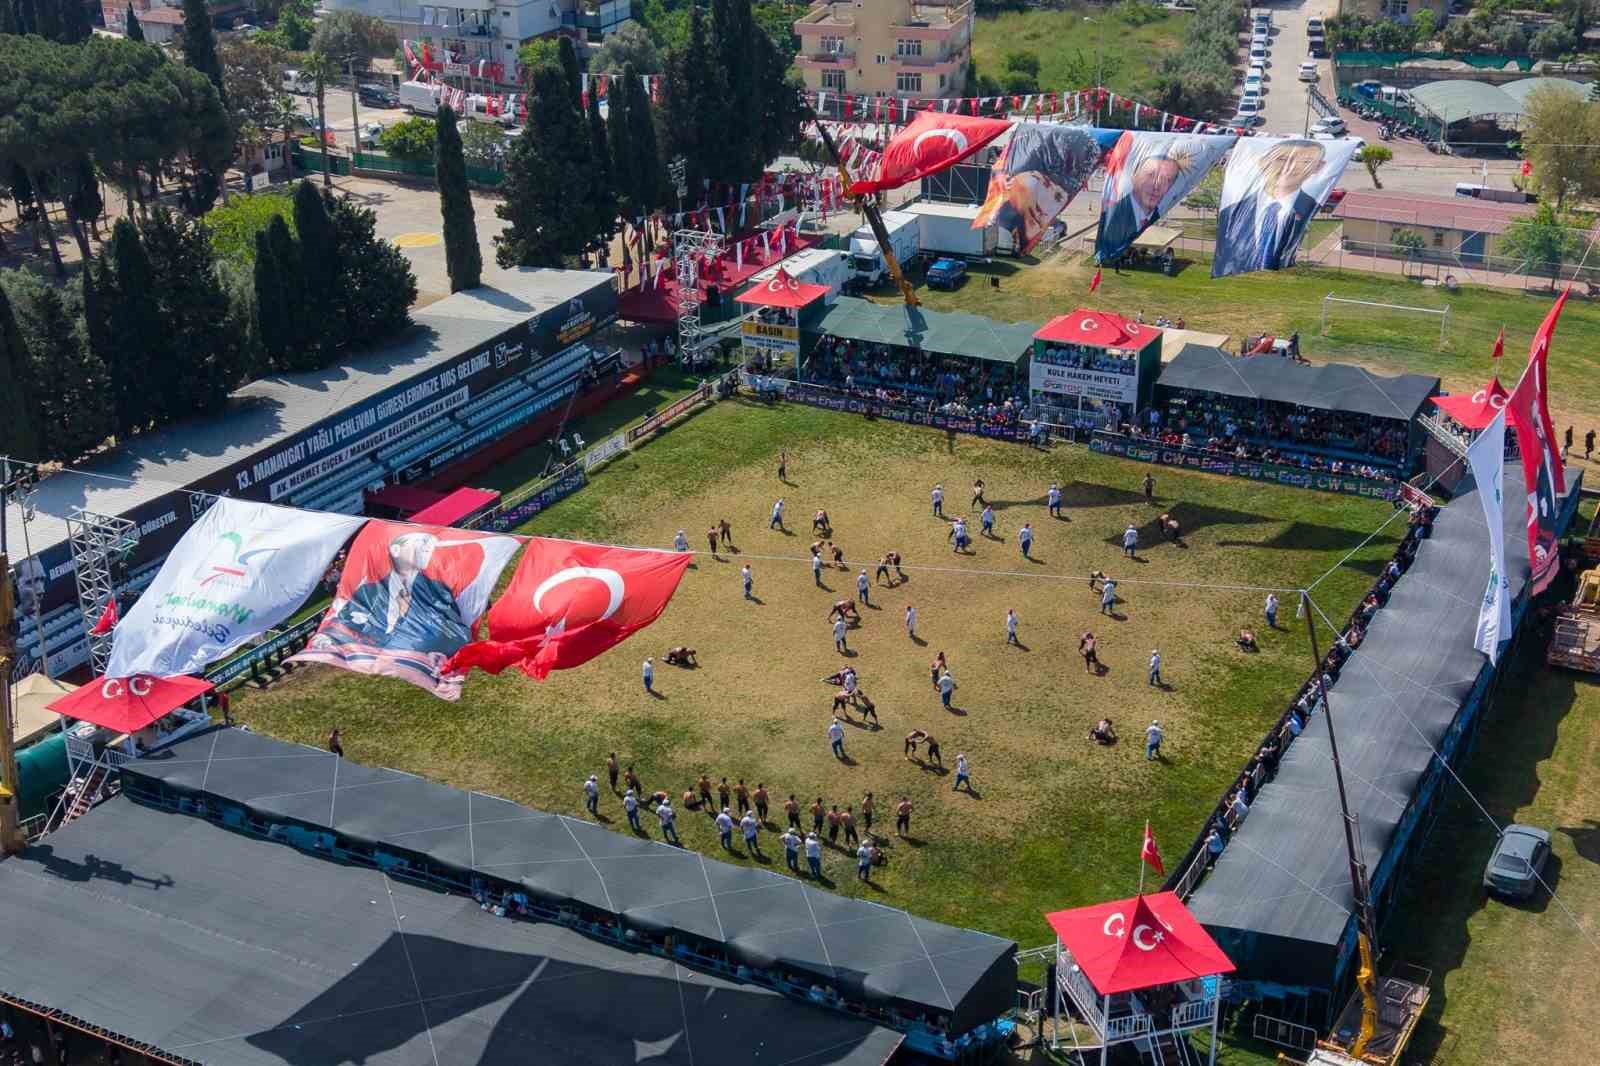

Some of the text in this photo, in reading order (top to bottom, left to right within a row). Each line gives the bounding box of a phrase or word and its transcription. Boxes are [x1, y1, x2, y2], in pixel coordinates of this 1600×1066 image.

[1067, 370, 1092, 381] HAKEM
[236, 469, 253, 491] 13.
[253, 441, 306, 483] MANAVGAT
[307, 428, 334, 457] YAĞLI
[334, 408, 377, 442] PEHLİVAN
[440, 369, 457, 391] HOŞ
